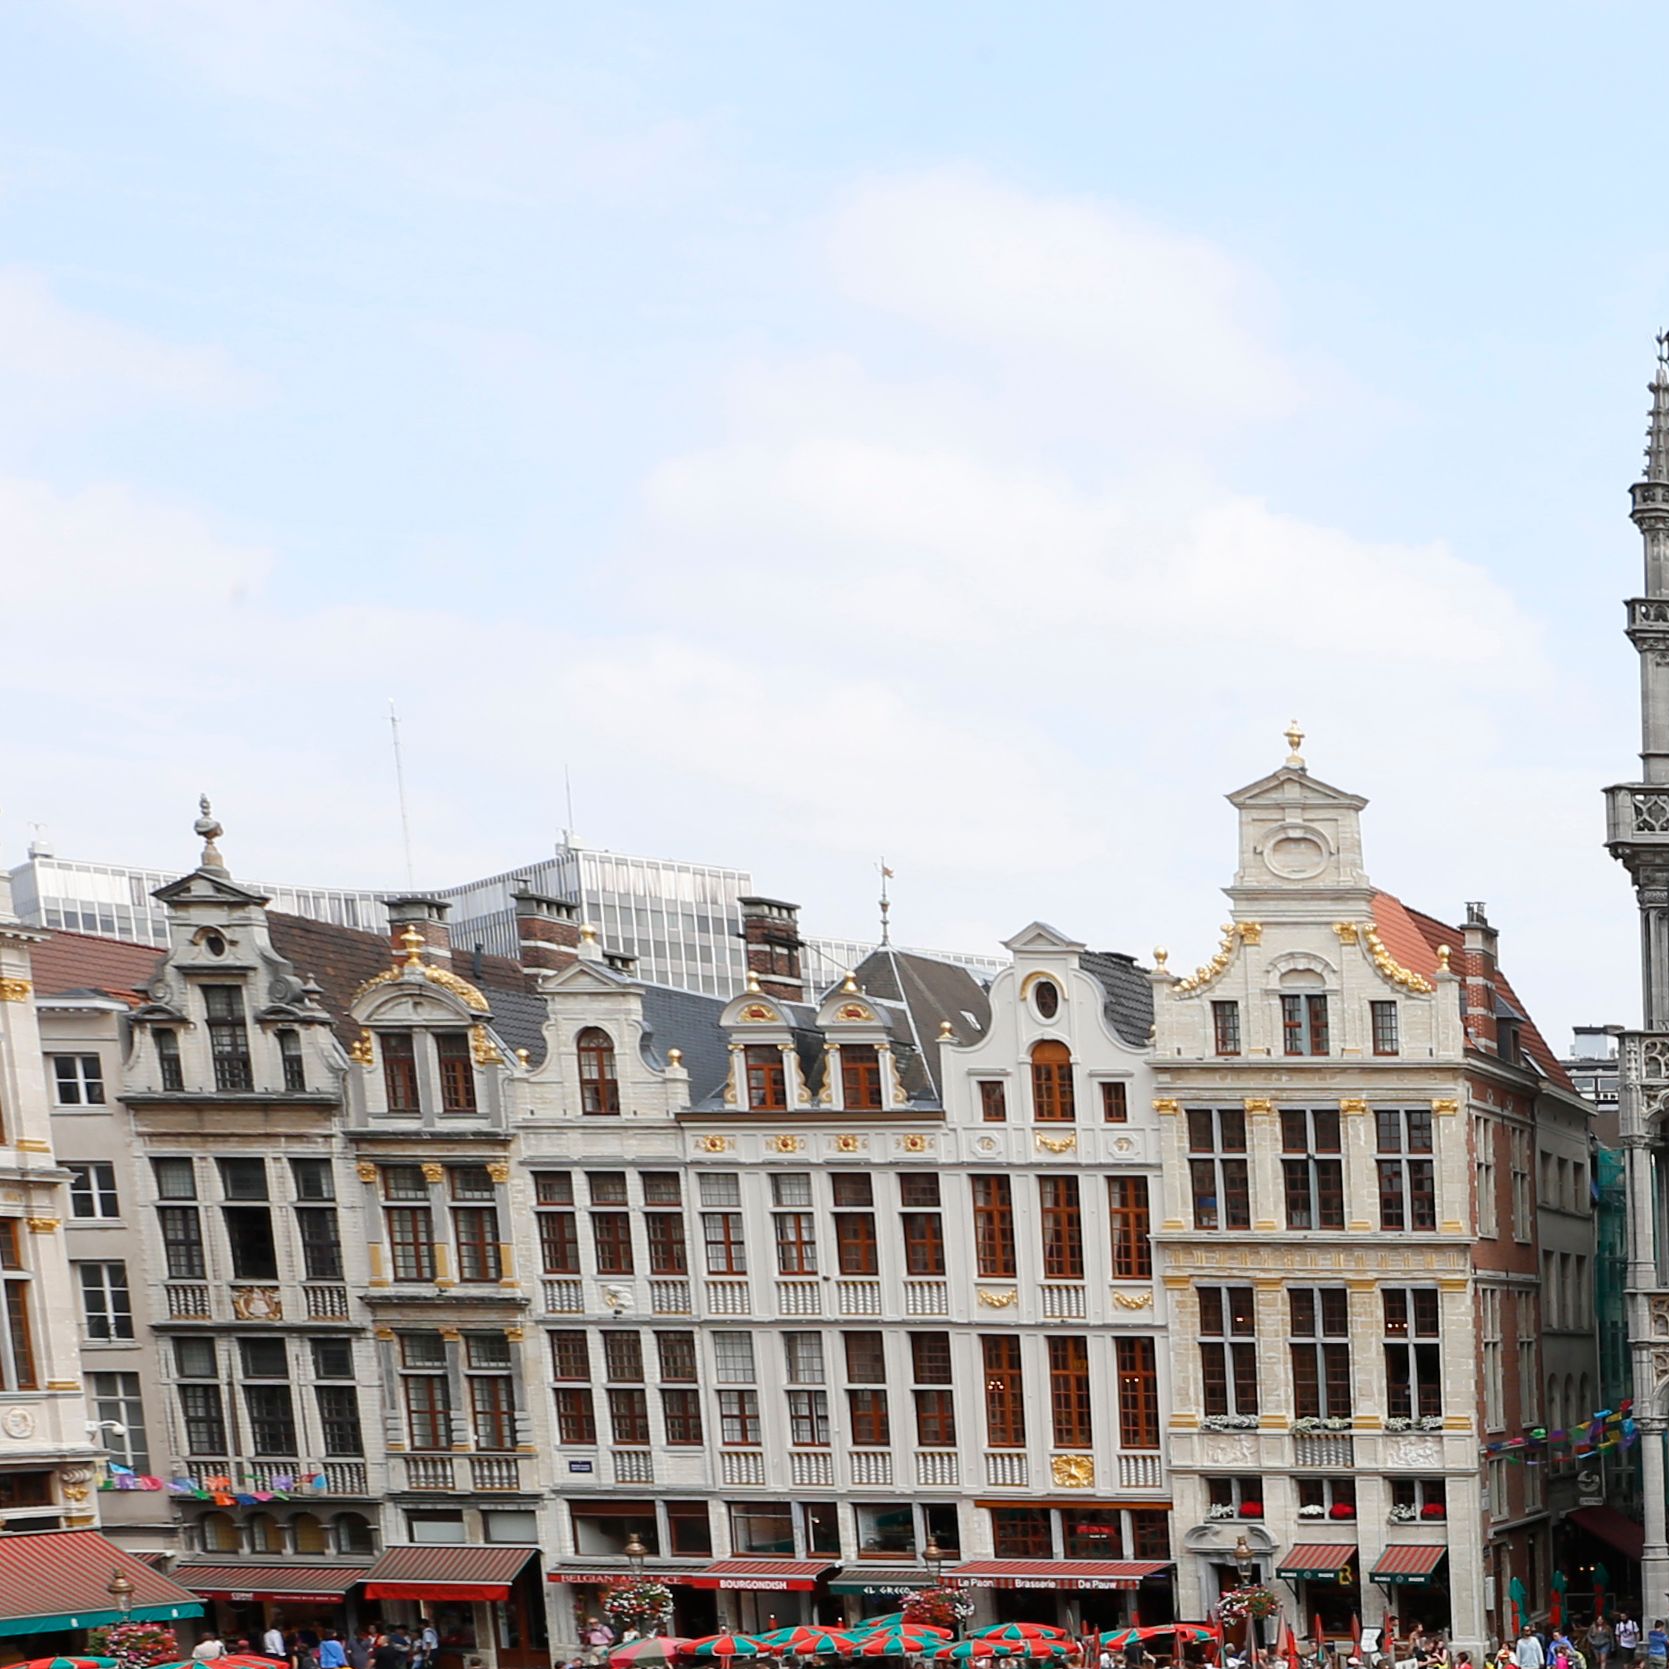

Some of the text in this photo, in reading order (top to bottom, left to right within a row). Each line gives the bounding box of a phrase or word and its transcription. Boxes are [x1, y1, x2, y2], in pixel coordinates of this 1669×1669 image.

[560, 1574, 614, 1584] BELGIAN
[719, 1579, 787, 1590] BOURGONDISH
[957, 1578, 1117, 1590] Le Paon Brasserie De Pauw
